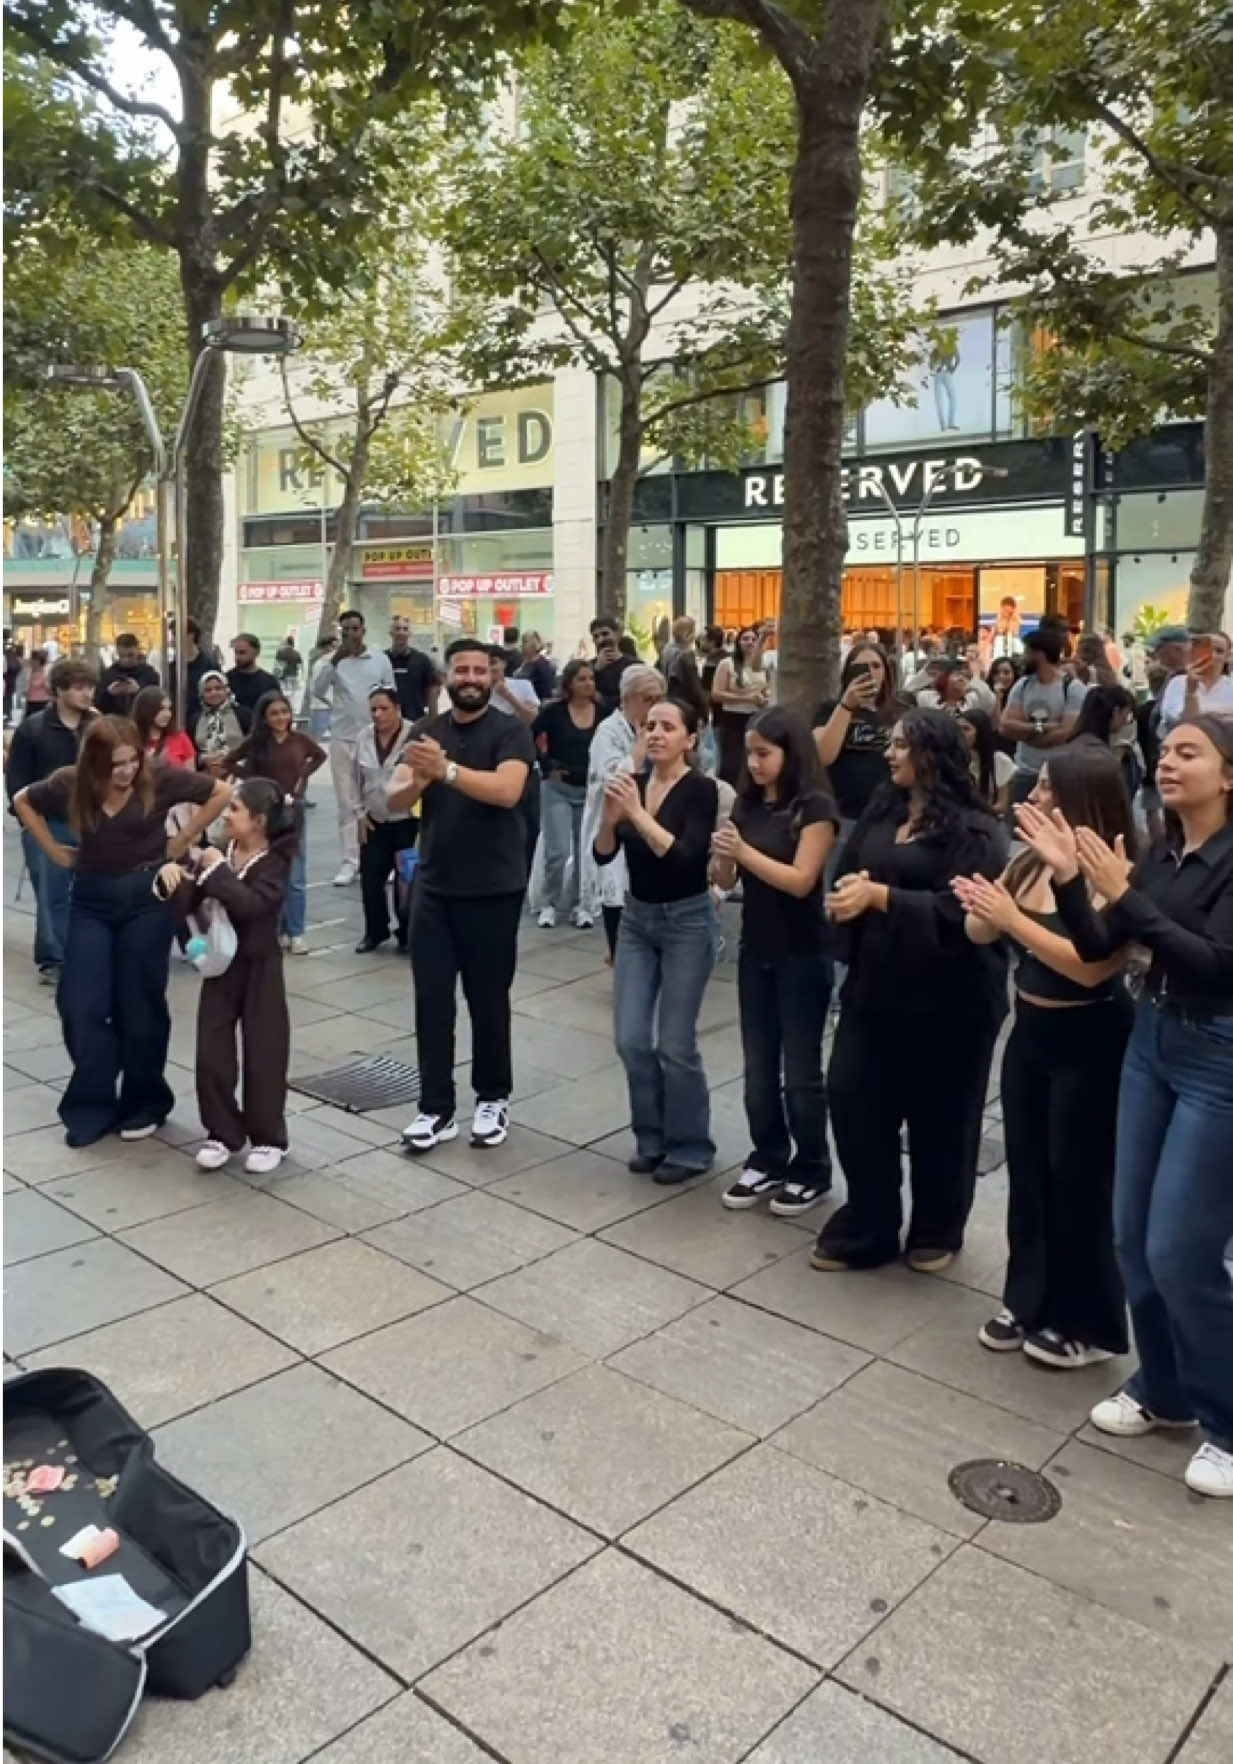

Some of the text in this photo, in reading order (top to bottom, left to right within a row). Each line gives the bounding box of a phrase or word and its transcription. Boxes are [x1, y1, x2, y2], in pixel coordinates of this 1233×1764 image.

[280, 409, 551, 491] REVED
[744, 457, 984, 507] RERVED
[856, 528, 961, 550] SERVED
[364, 551, 387, 561] POP
[389, 550, 403, 561] UP
[248, 584, 312, 598] POP UP OUTLET
[451, 576, 540, 594] POP UP OUTLET
